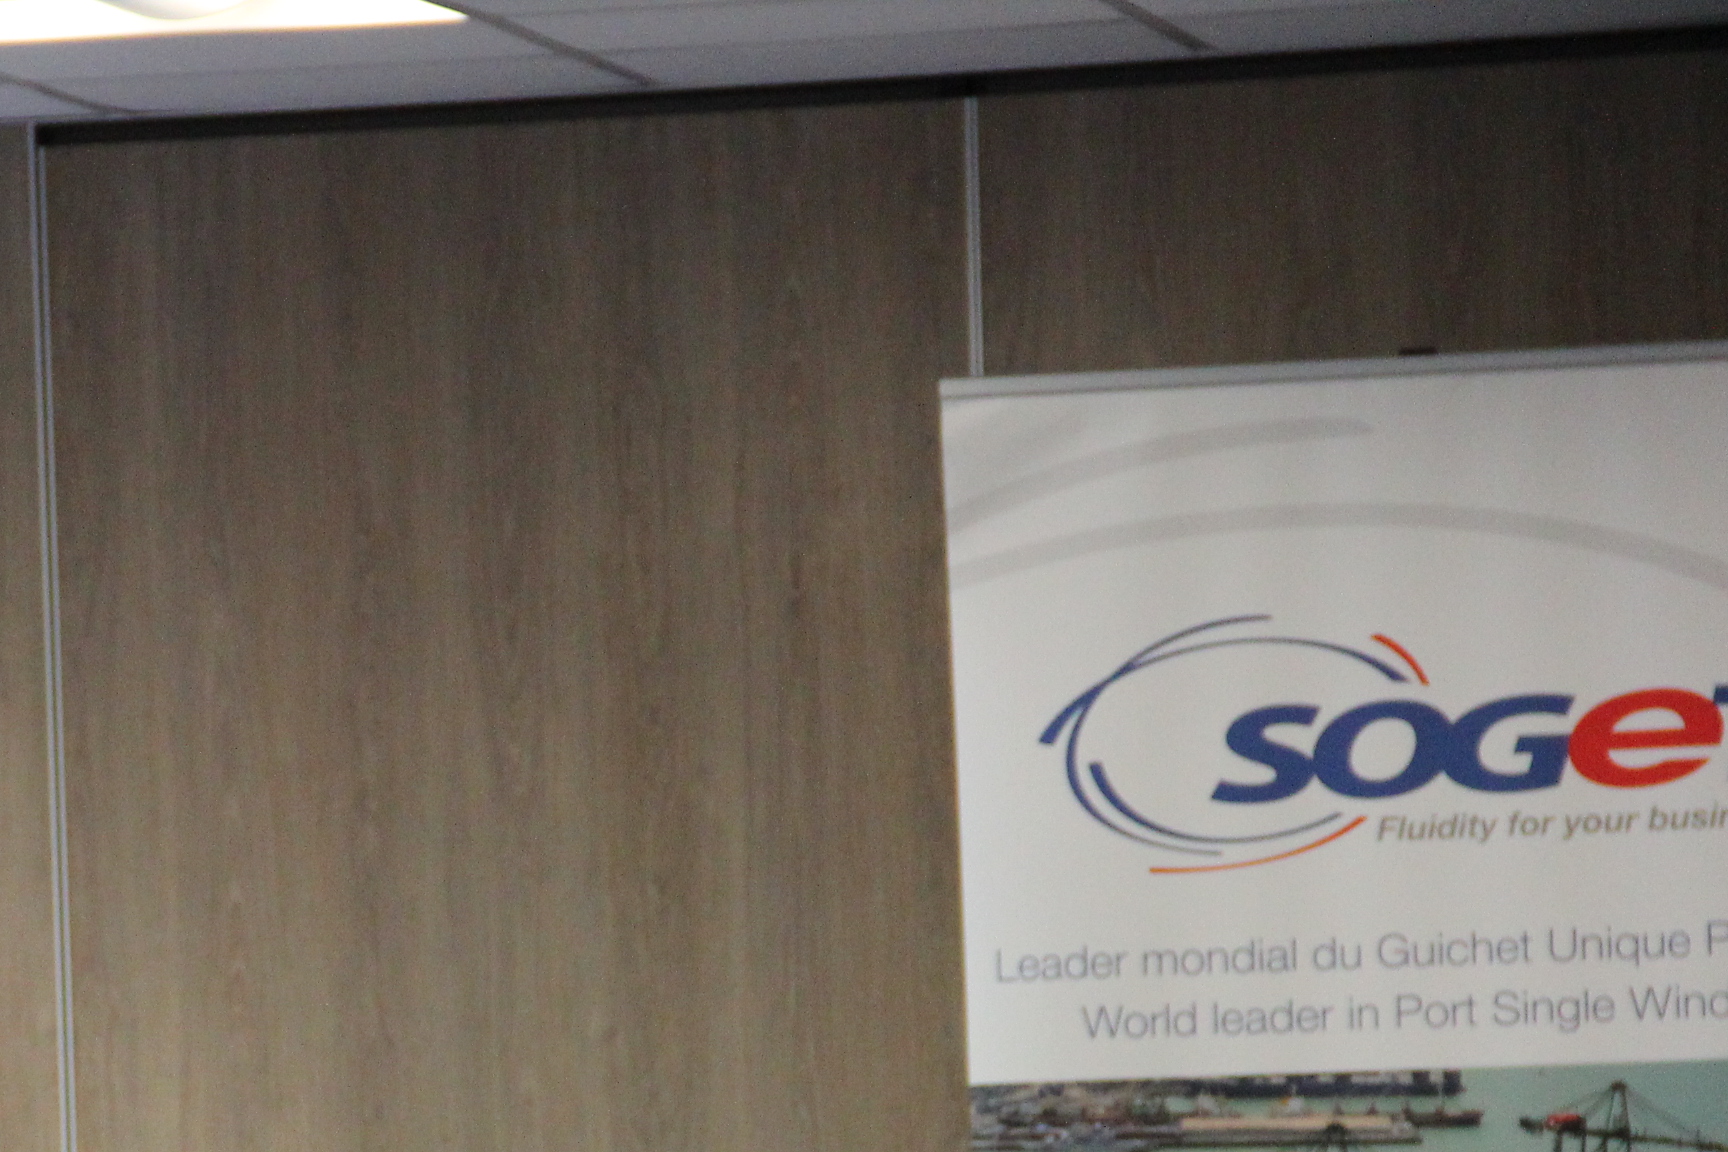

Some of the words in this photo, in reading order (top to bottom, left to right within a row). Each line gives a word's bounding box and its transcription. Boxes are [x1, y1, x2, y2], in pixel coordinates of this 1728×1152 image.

[1377, 814, 1497, 843] Fluidity
[1508, 810, 1558, 837] for
[1563, 810, 1639, 840] your
[995, 945, 1128, 983] Leader
[1142, 937, 1297, 976] mondial
[1312, 937, 1362, 973] du
[1377, 929, 1533, 970] Guichet
[1547, 925, 1692, 968] Unique
[1081, 1001, 1198, 1040] World
[1212, 1000, 1335, 1036] leader
[1347, 997, 1379, 1030] in
[1395, 992, 1476, 1030] Port
[1493, 988, 1616, 1034] Single
